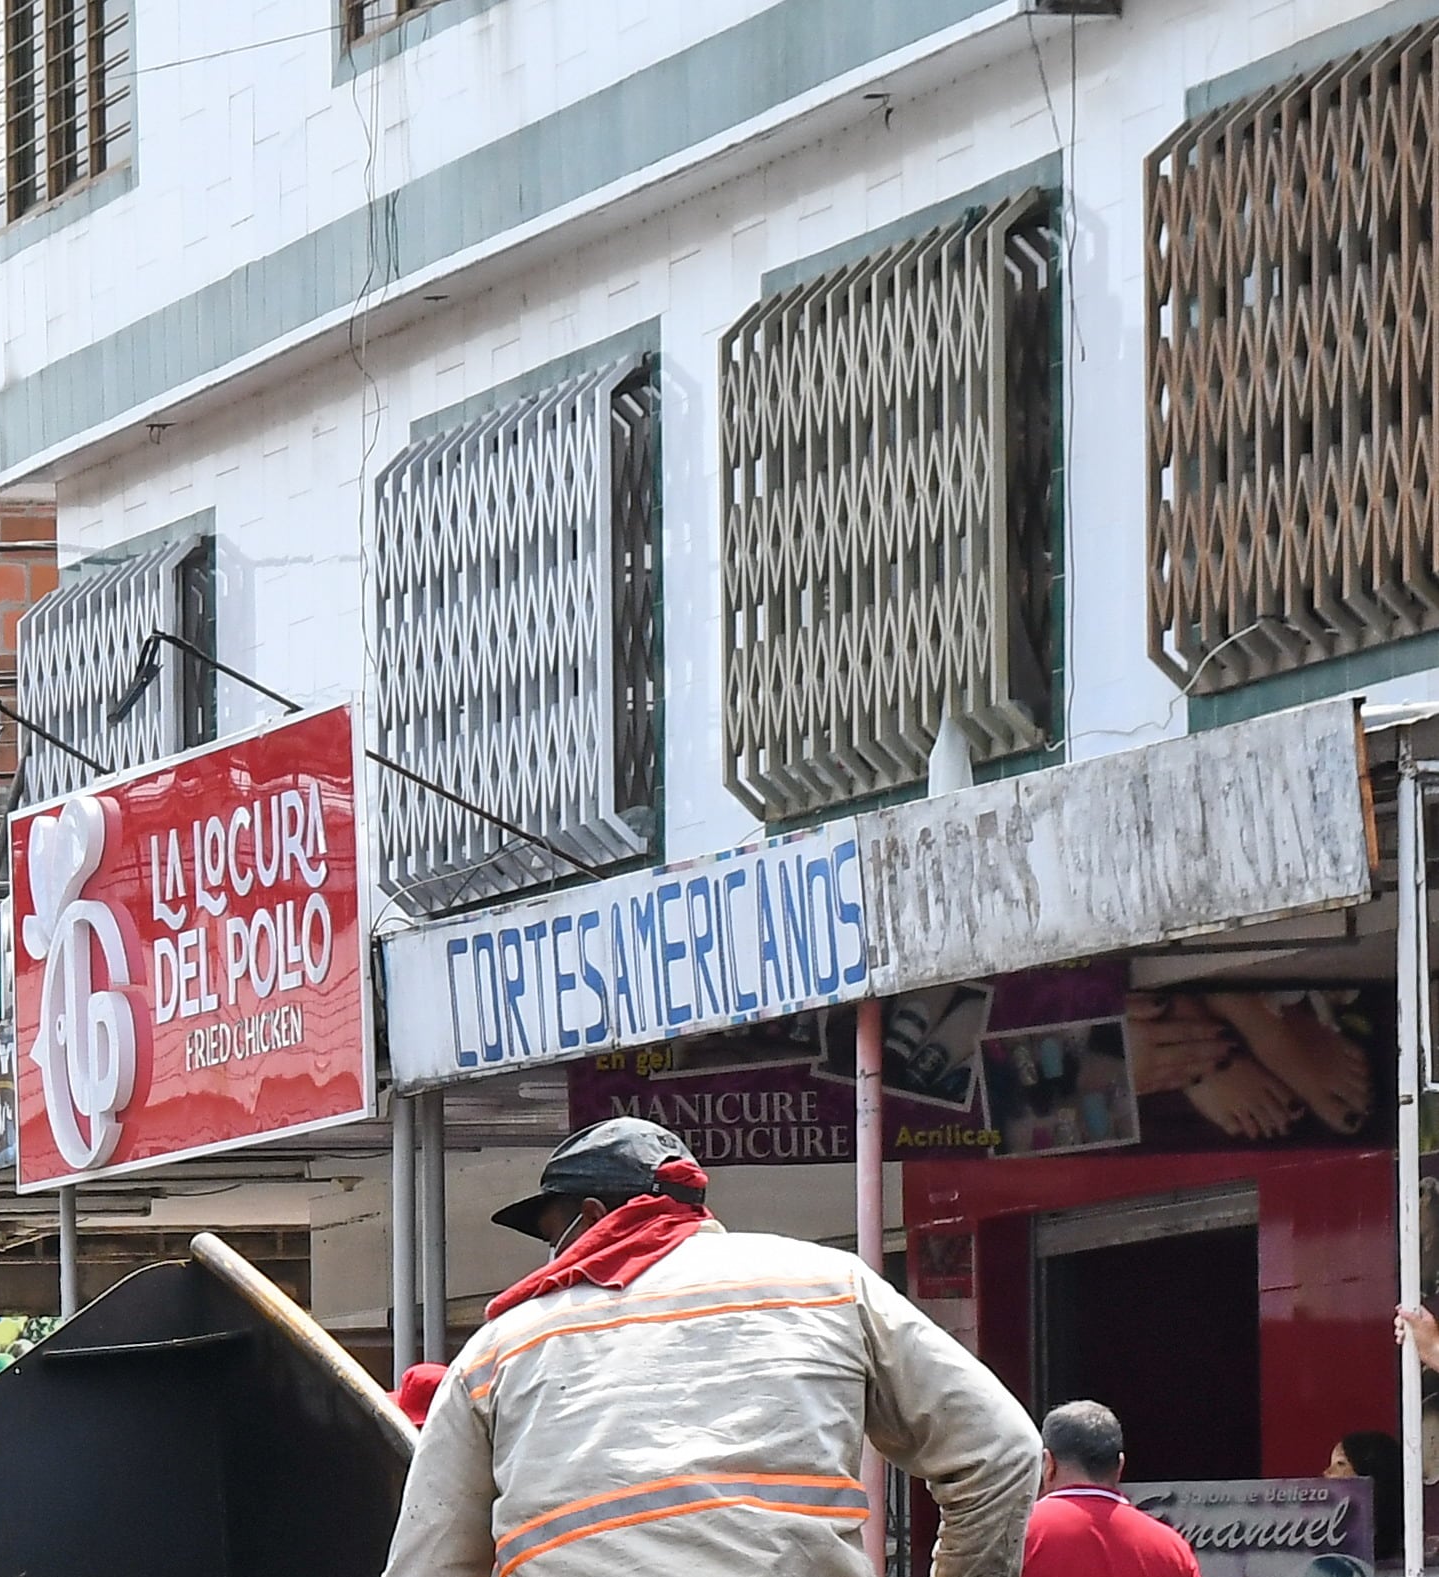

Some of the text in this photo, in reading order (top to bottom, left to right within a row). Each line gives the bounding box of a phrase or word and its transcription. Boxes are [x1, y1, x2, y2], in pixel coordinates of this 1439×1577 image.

[151, 783, 328, 930] LA LOCURA
[153, 893, 332, 1024] DEL POLLO
[185, 1003, 304, 1073] FRIED CHICKEN
[610, 1091, 819, 1126] MANICURE
[678, 1125, 851, 1161] EDICURE
